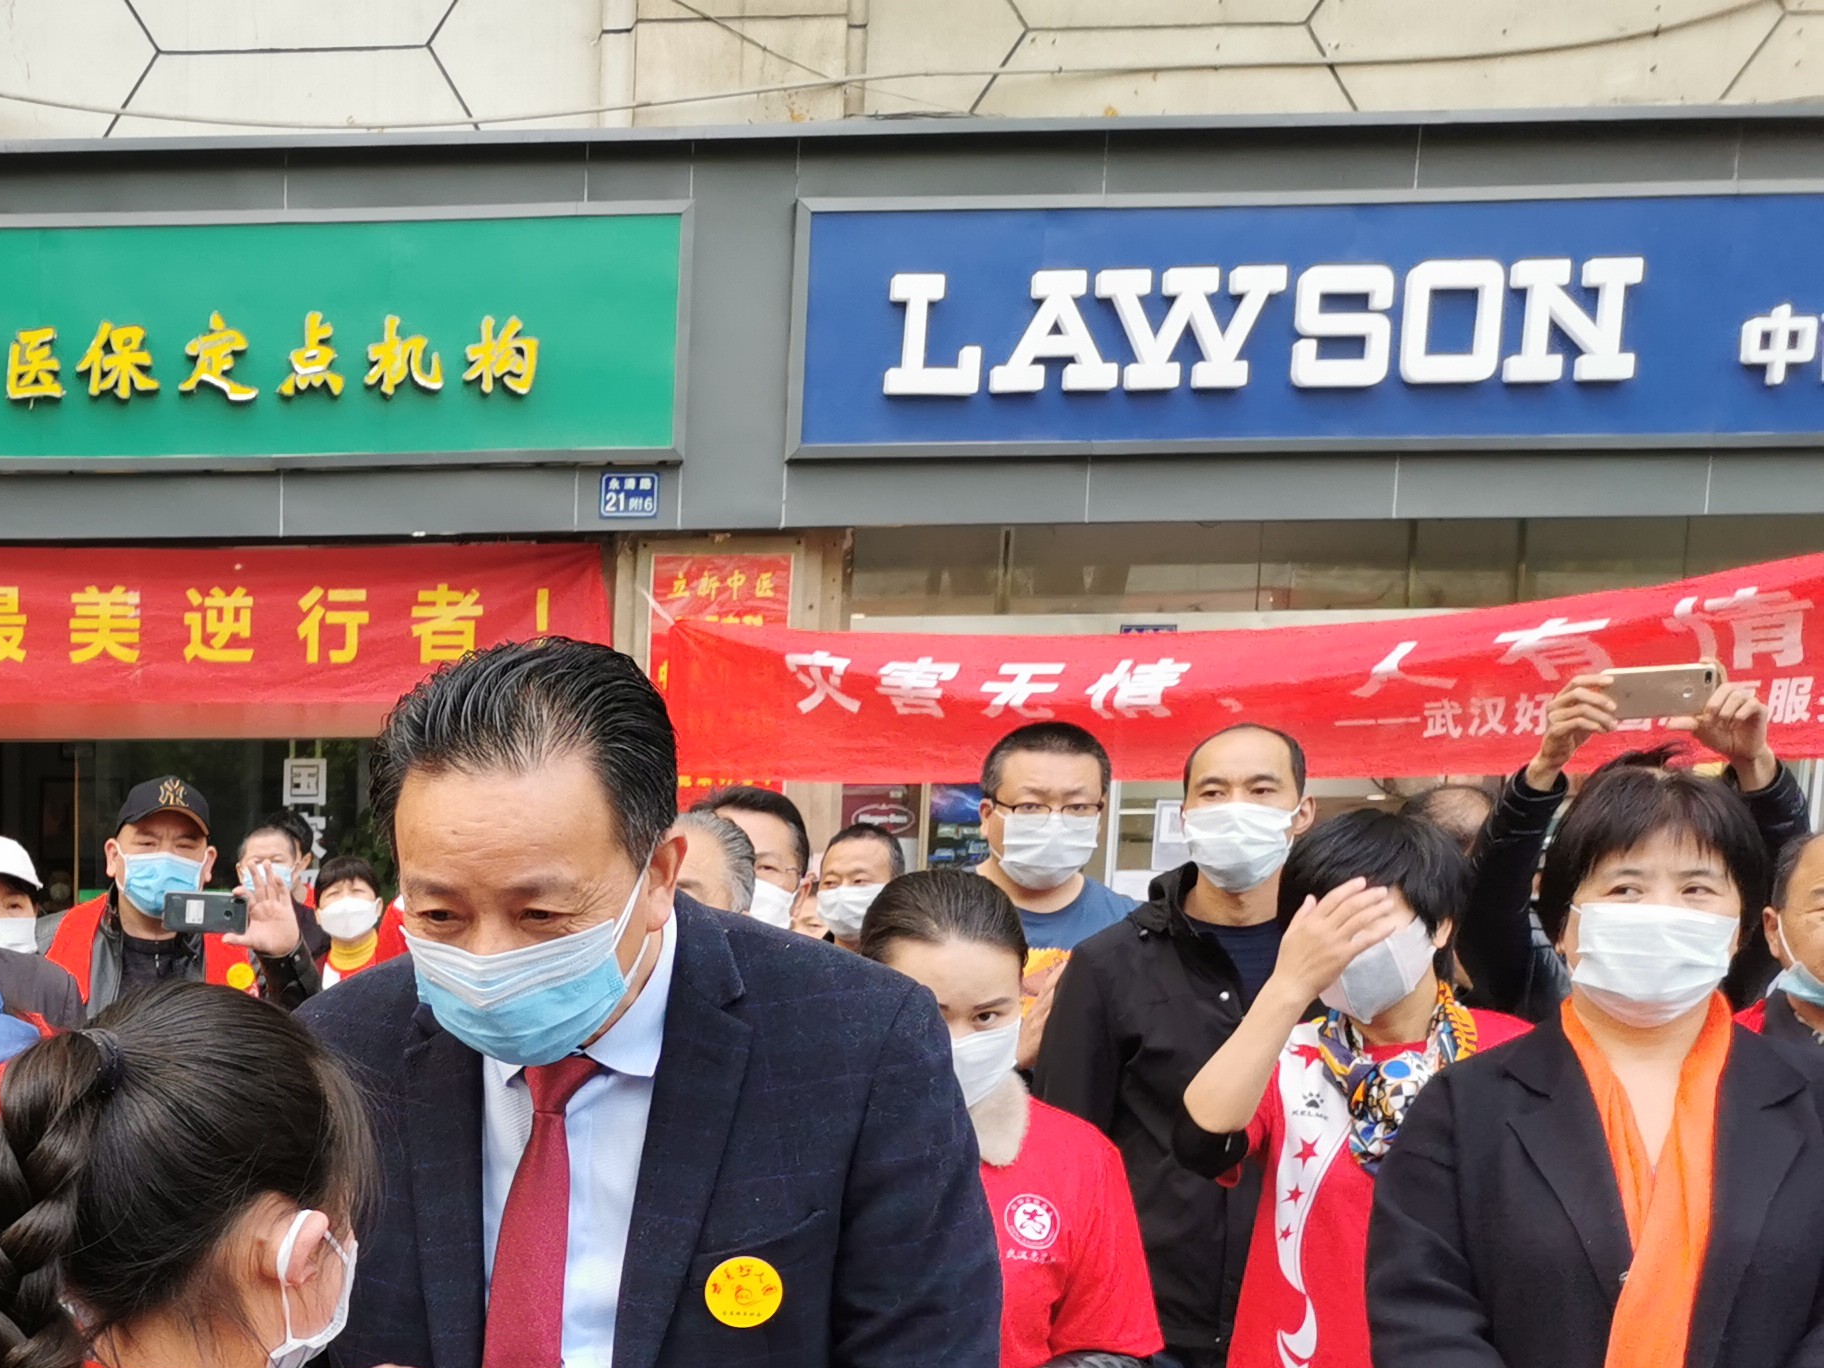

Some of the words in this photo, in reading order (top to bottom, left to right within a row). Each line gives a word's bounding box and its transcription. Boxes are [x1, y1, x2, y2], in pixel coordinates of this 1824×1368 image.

[884, 256, 1646, 398] LAWSON
[1738, 302, 1824, 387] 中
[666, 569, 775, 601] 立新中医
